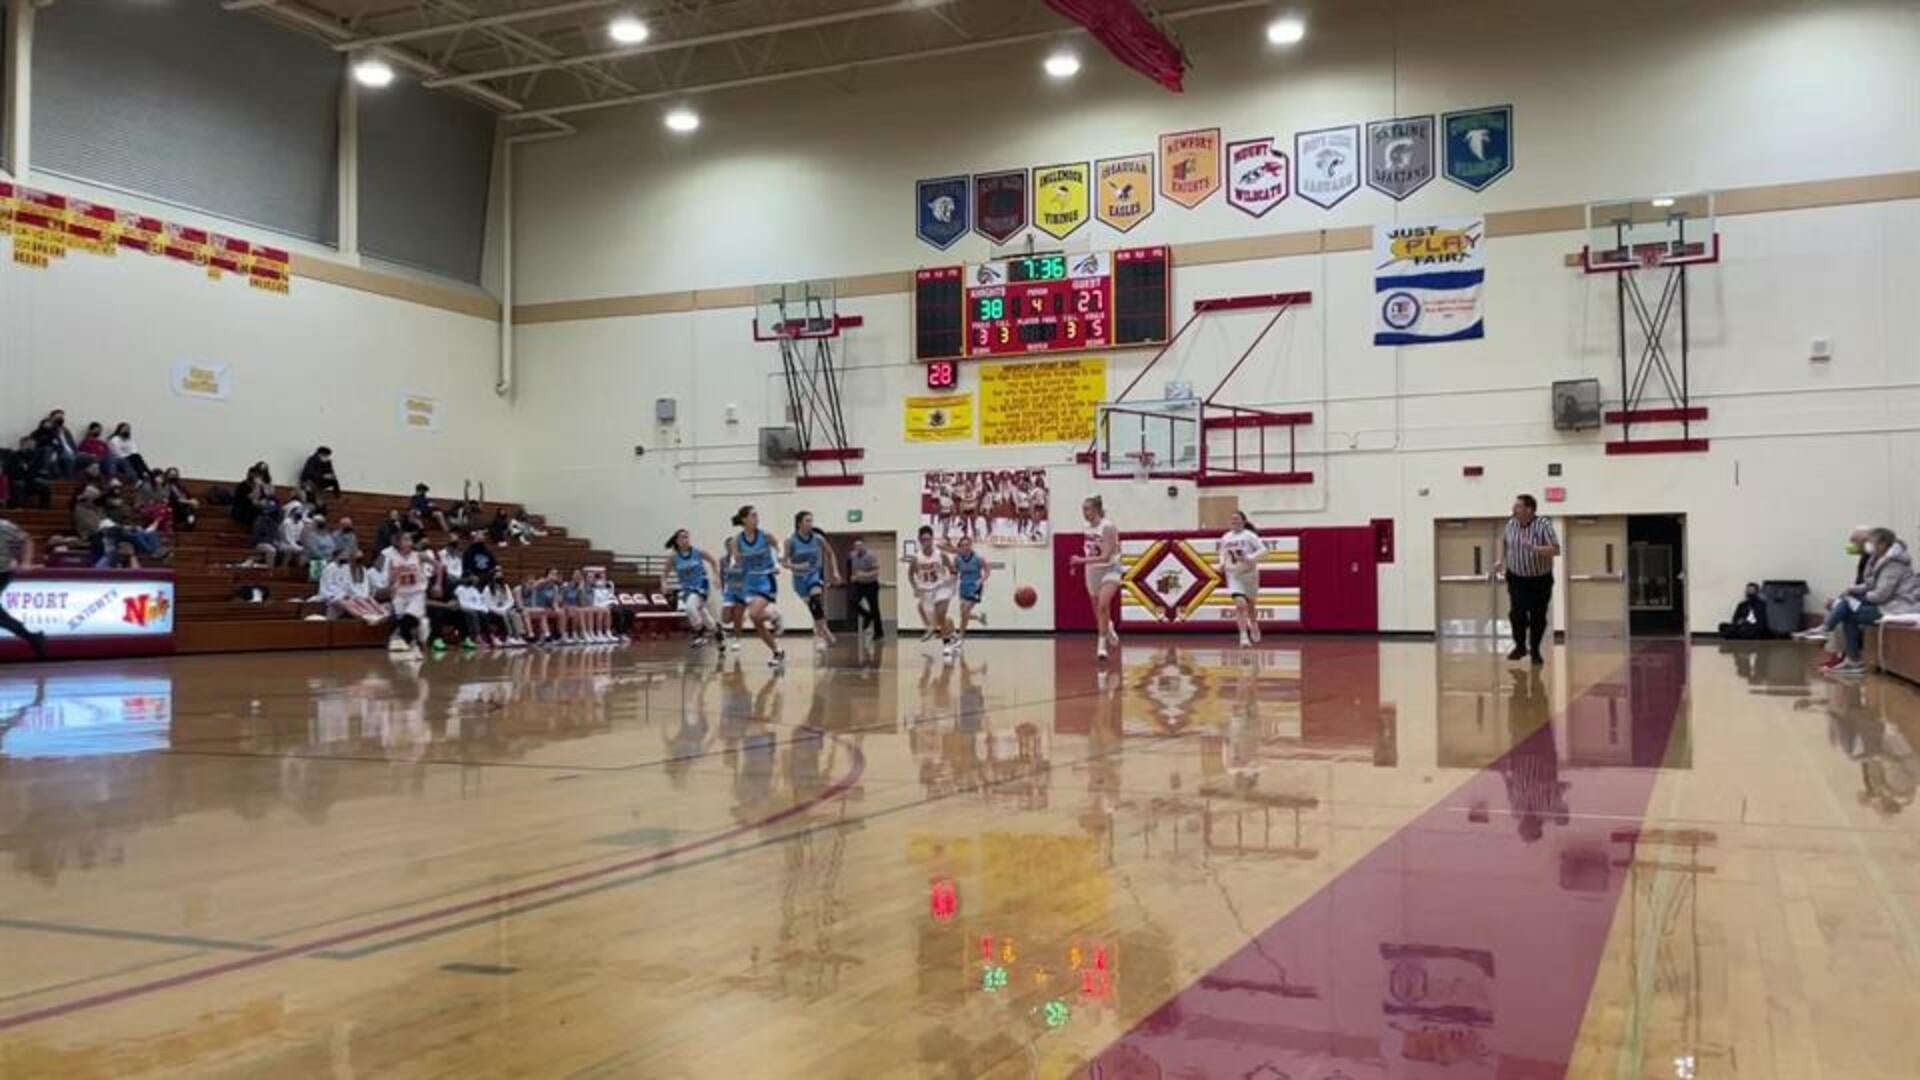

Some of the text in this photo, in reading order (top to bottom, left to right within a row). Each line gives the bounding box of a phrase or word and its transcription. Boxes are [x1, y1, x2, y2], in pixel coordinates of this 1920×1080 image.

[1374, 123, 1425, 142] SKYLINE
[1167, 137, 1213, 154] NEWPORT
[1233, 144, 1268, 164] MOUNT
[1040, 169, 1082, 188] INGLEMOOR
[1376, 166, 1425, 183] SPARTANS
[1172, 176, 1209, 193] KNIGHTS
[1235, 183, 1281, 202] WILDCATS
[1044, 209, 1079, 225] VIKINGS
[1109, 201, 1140, 217] EAGLES
[1387, 226, 1437, 239] JUST
[1405, 233, 1481, 254] PLAY
[1024, 257, 1064, 280] 7:36
[971, 287, 1006, 299] KNIGHTS
[1071, 278, 1101, 291] GUEST
[980, 298, 1004, 321] 38
[1031, 297, 1043, 313] 4
[1077, 289, 1103, 312] 27
[980, 328, 989, 346] 3
[1000, 326, 1010, 344] 3
[1066, 320, 1077, 339] 3
[1091, 319, 1103, 337] 5
[929, 364, 952, 386] 28
[68, 588, 119, 631] KNIGHTS
